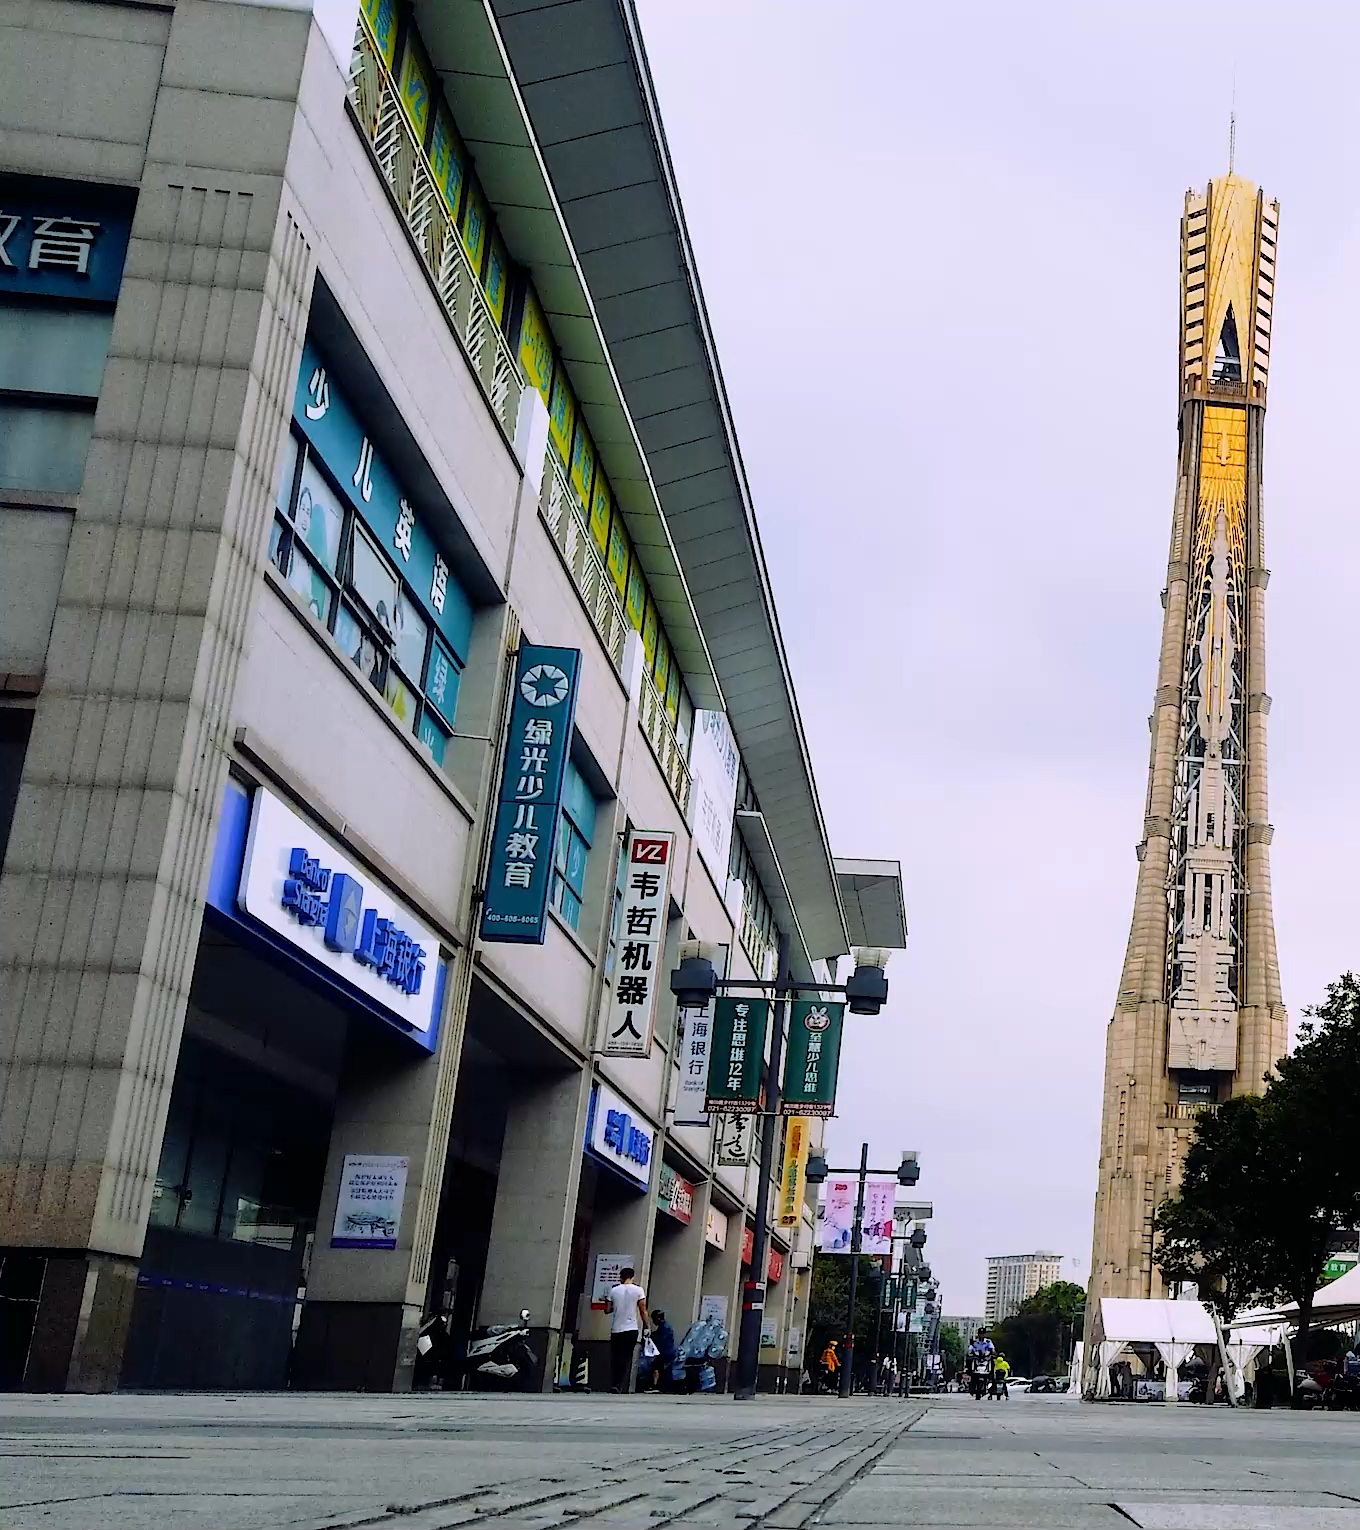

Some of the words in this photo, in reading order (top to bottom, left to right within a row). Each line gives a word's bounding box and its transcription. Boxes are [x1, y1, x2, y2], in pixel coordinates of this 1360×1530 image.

[305, 367, 449, 615] 少儿英语
[503, 718, 553, 889] 绿光少儿教育
[282, 880, 329, 927] Shangha
[353, 908, 427, 995] 上海银行
[611, 871, 661, 1040] 韦哲机器人
[688, 1007, 710, 1075] 上海银行
[726, 1003, 750, 1092] 专注思维12年
